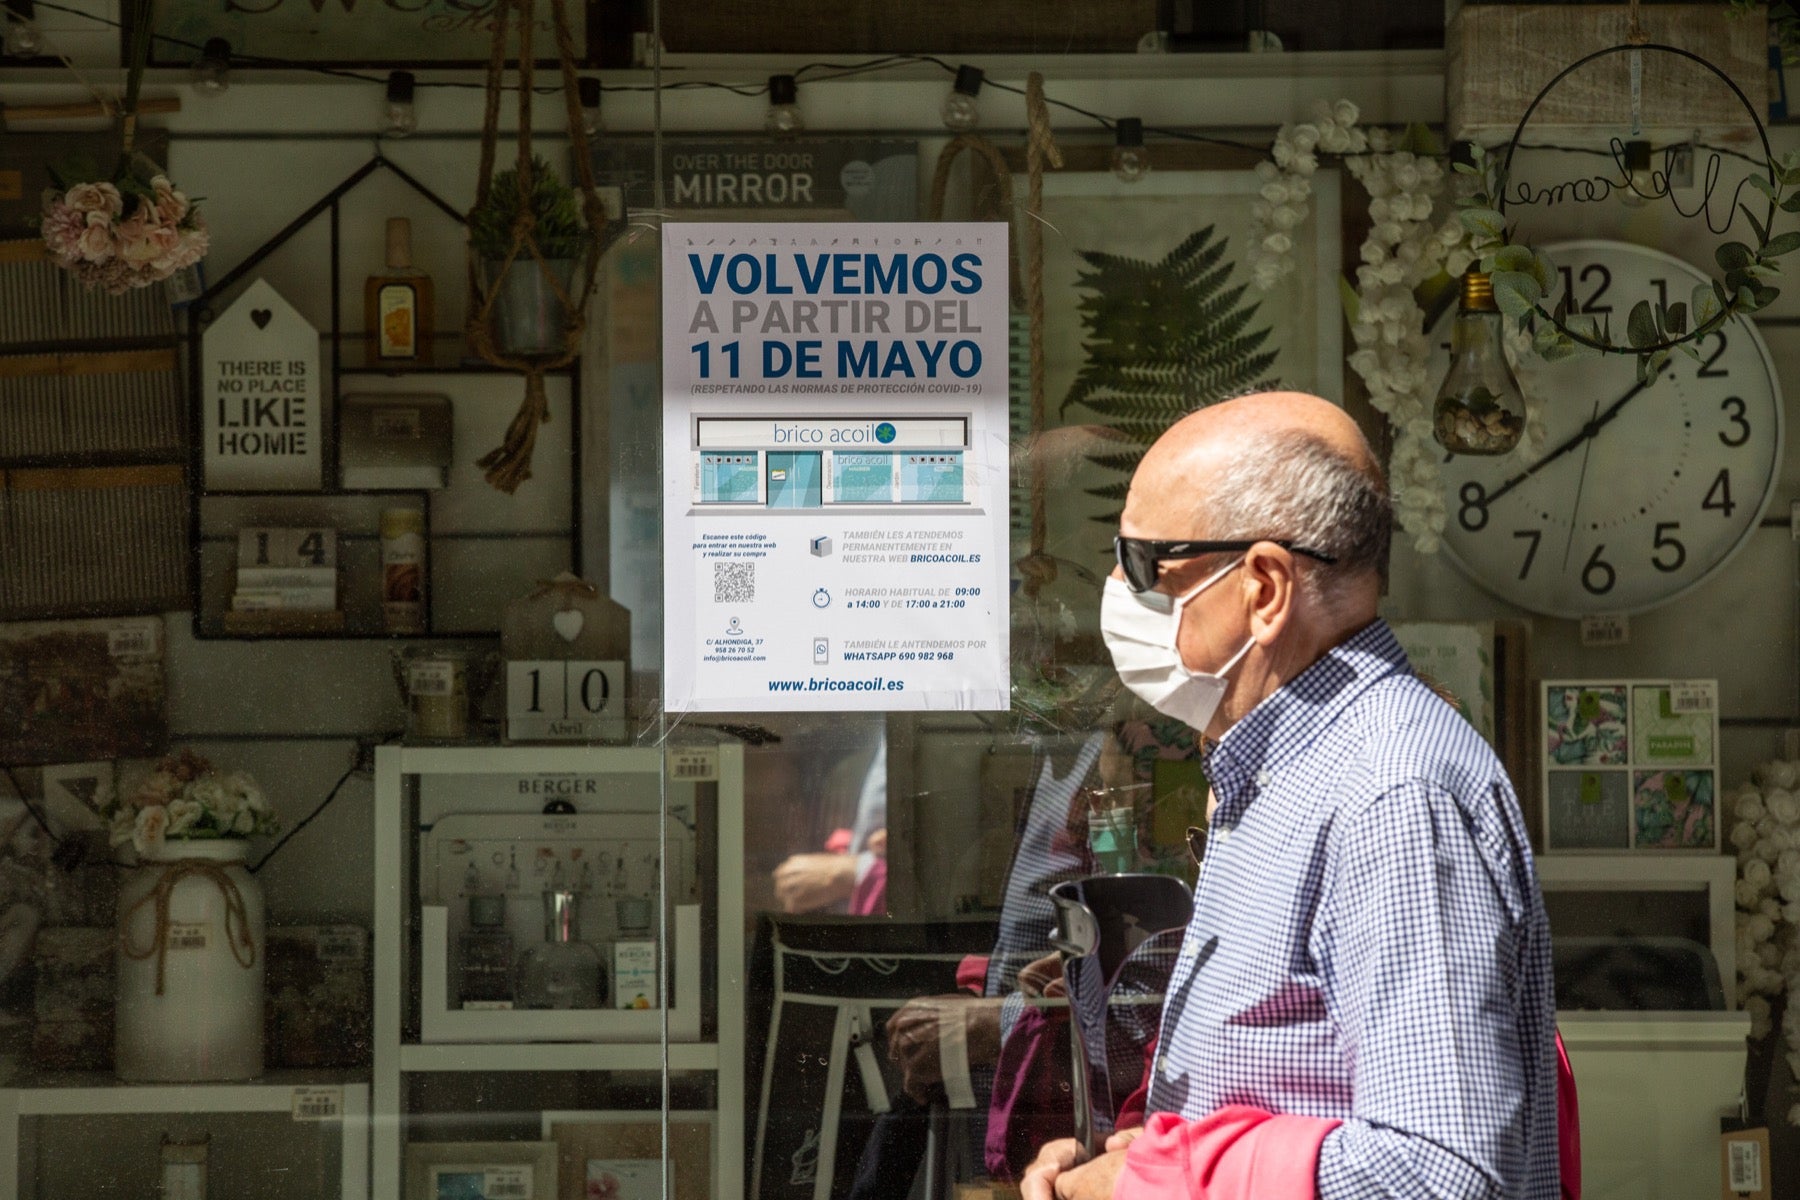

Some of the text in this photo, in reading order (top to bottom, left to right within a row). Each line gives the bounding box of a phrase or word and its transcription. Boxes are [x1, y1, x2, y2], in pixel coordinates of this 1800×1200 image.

[672, 153, 814, 170] OVER THE DOOR
[673, 173, 813, 203] MIRROR
[687, 252, 983, 295] VOLVEMOS
[1558, 264, 1612, 315] 12
[688, 300, 982, 334] A PARTIR DEL
[690, 340, 982, 378] 11 DE MAYO
[1697, 330, 1729, 378] 2
[218, 361, 305, 376] THERE IS
[218, 379, 306, 393] NO PLACE
[691, 381, 983, 395] (RESPETANDO LAS NORMAS DE PROTECCIÓN COVID-19)
[219, 397, 306, 428] LIKE
[1719, 397, 1750, 447] 3
[219, 432, 306, 455] HOME
[774, 423, 875, 444] brico acoil
[1702, 469, 1736, 517] 4
[1458, 481, 1489, 532] 8
[842, 529, 964, 539] TAMBIÉN LES ATENDEMOS
[298, 531, 326, 565] 4
[692, 542, 707, 550] para
[842, 542, 953, 552] PERMANENTEMENTE EN
[1513, 530, 1542, 580] 7
[1652, 522, 1686, 573] 5
[842, 554, 982, 563] NUESTRA WEB BRICOACOIL.ES
[1581, 545, 1616, 595] 6
[845, 587, 981, 597] HORARIO HABITUAL DE 09:00
[855, 599, 881, 608] 14:00
[883, 600, 888, 608] Y
[890, 600, 903, 608] DE
[905, 600, 930, 608] 17:00
[939, 600, 966, 608] 21:00
[843, 638, 987, 649] TAMBIÉN LE ANTENDEMOS POR
[843, 652, 954, 660] WHATSAPP 690 982 968
[527, 668, 609, 713] 1 0
[768, 677, 905, 691] www.bricoacoil.es
[549, 722, 583, 735] Abril
[518, 780, 597, 794] BERGER
